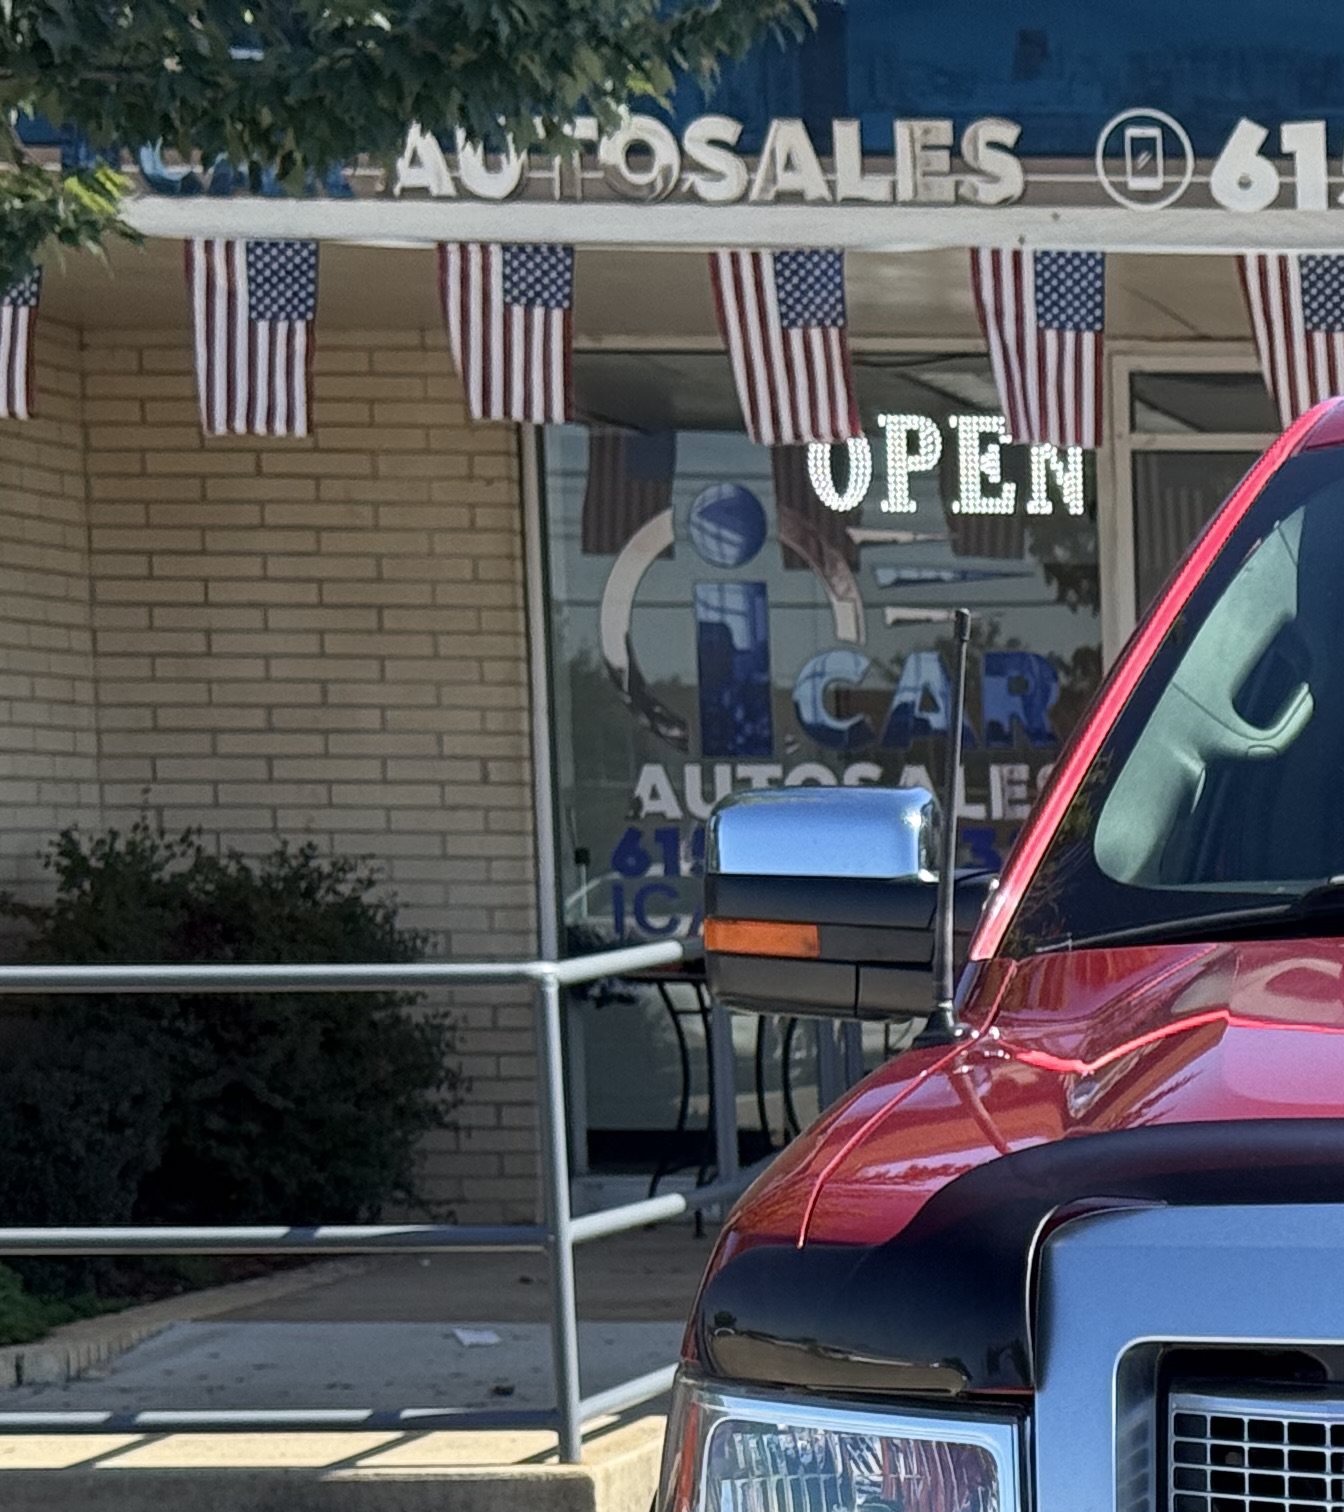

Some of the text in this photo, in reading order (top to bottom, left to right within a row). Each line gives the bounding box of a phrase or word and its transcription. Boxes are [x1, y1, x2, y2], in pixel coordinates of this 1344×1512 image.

[393, 116, 1025, 204] AUTOSALES
[807, 413, 1085, 514] OPEN
[791, 650, 1060, 749] CAR
[633, 762, 1056, 821] AUTLE
[612, 883, 704, 937] IC
